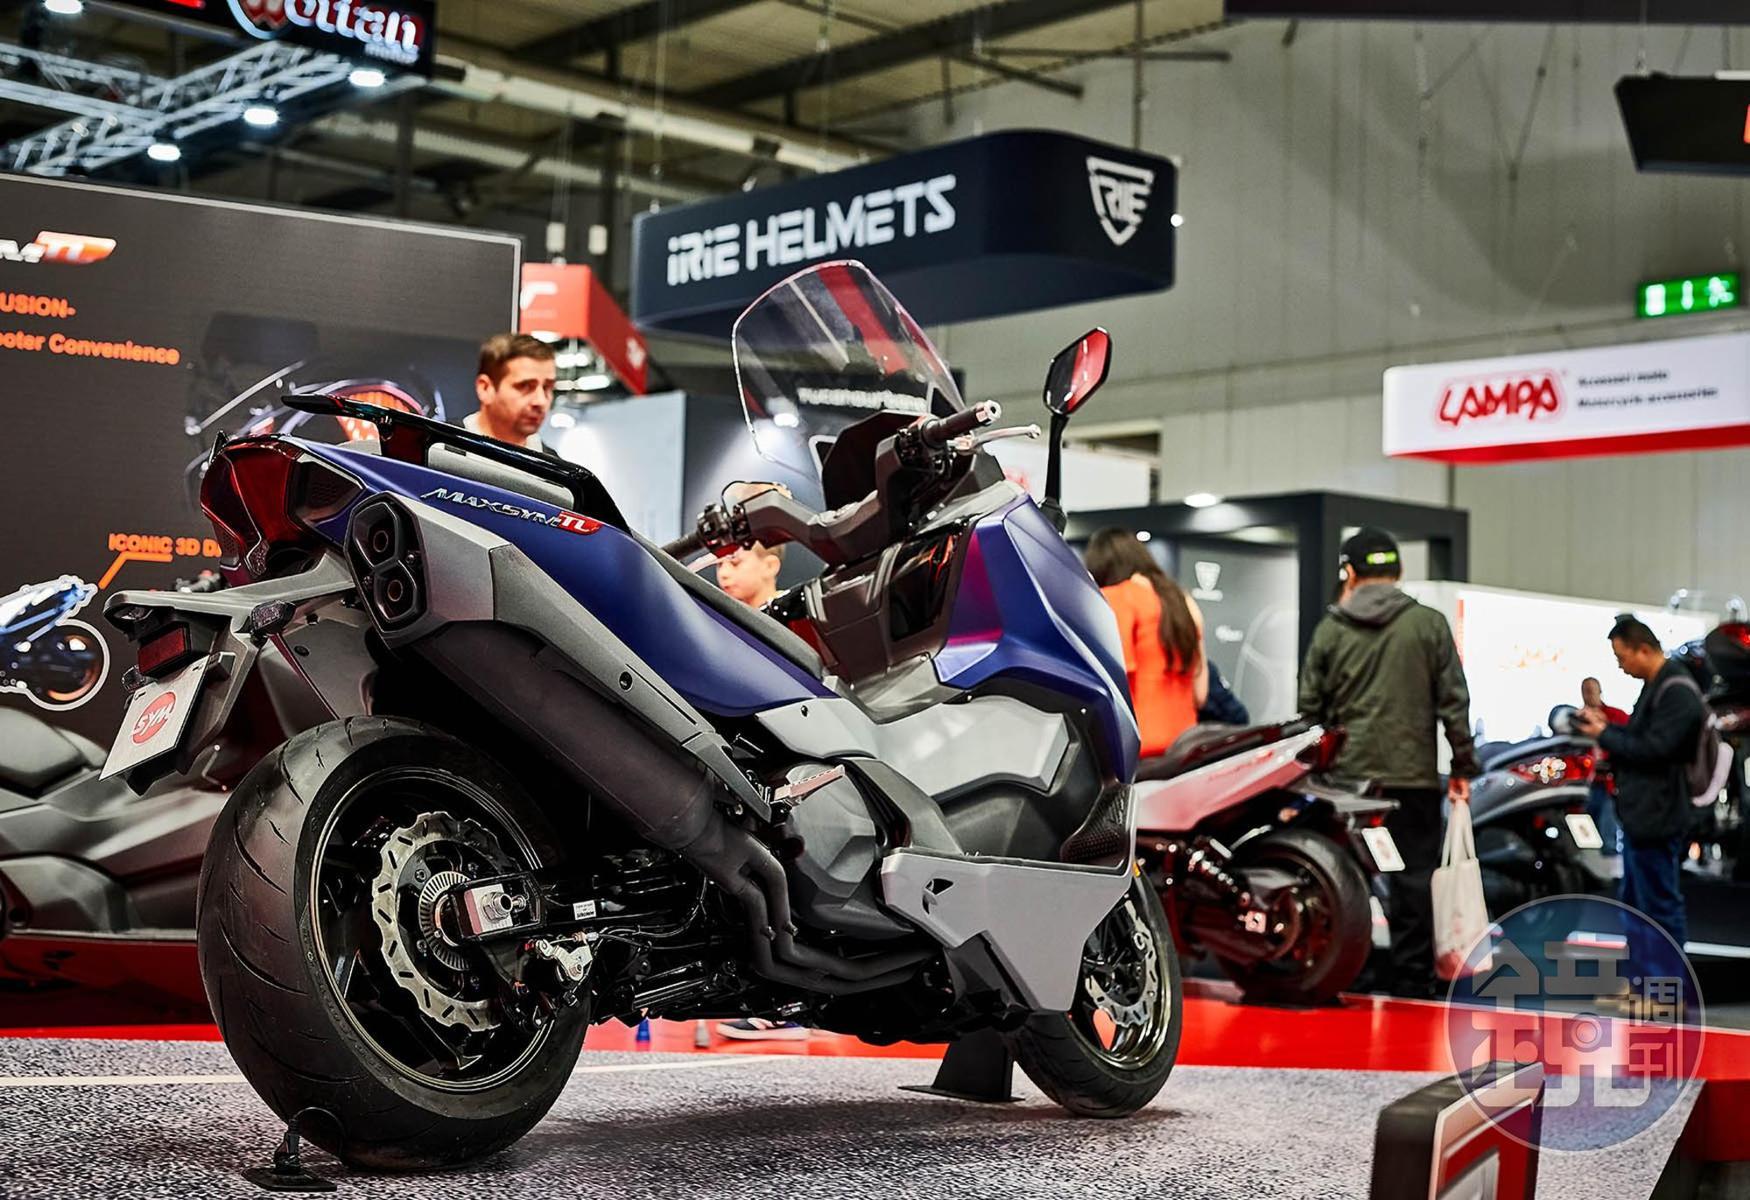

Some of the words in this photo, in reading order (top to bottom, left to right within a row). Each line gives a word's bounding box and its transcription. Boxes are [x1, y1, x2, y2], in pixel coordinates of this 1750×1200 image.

[746, 174, 956, 270] HELMETS
[0, 331, 46, 350] oter
[49, 333, 180, 365] Convenience
[1440, 379, 1558, 426] LAMPA
[109, 533, 173, 554] ICONIC
[175, 538, 200, 556] 3D
[133, 702, 174, 736] SYM
